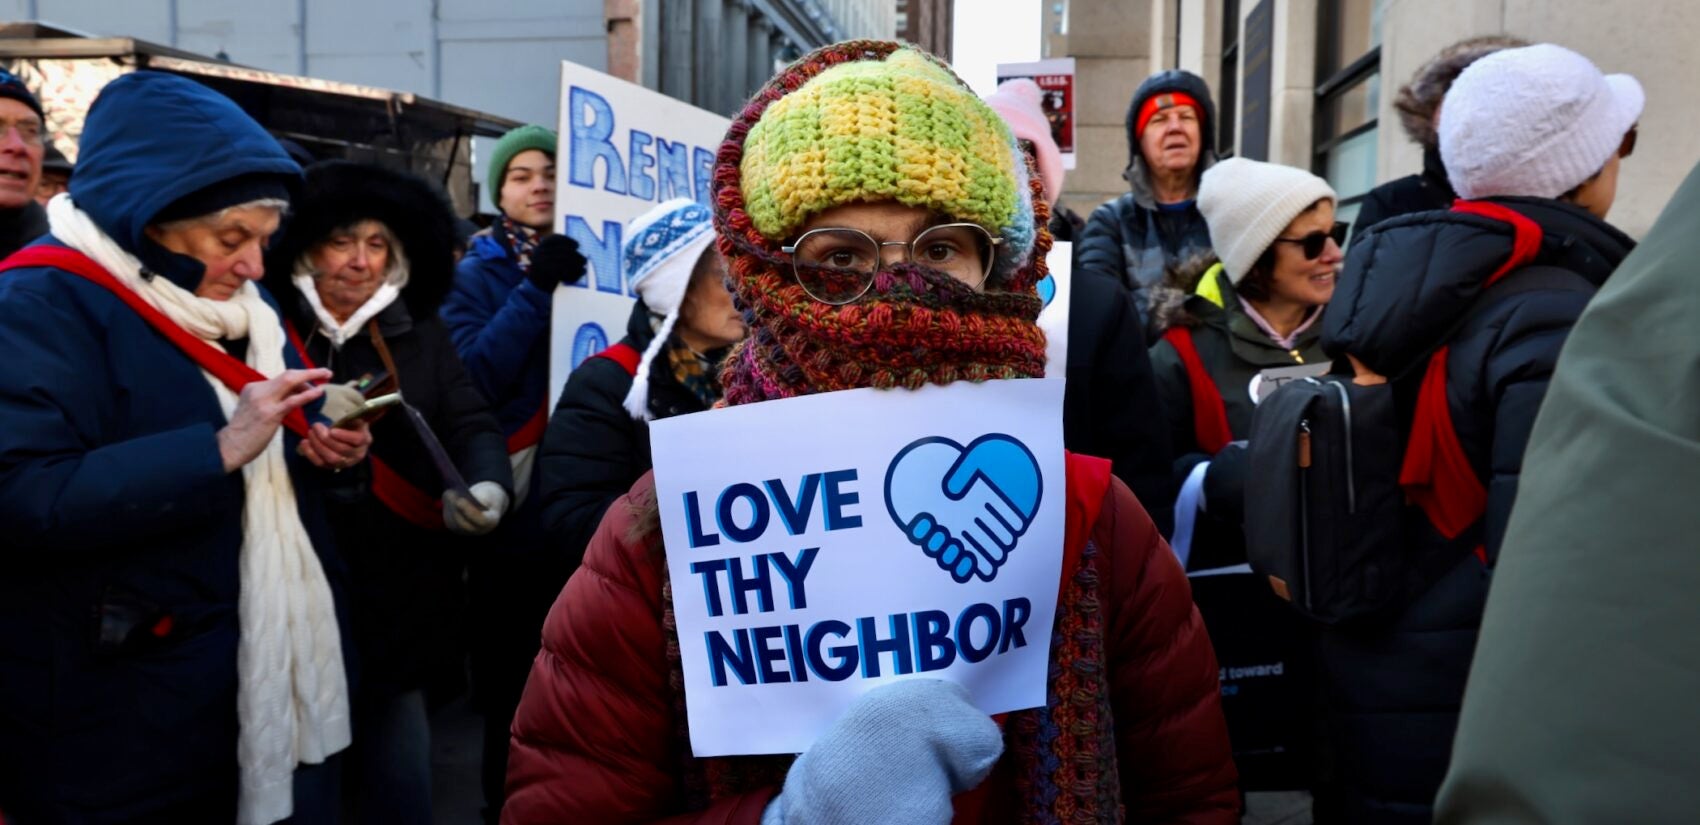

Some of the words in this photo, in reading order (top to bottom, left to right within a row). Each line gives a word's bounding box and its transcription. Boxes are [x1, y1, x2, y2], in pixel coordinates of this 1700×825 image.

[568, 85, 716, 205] RENE
[682, 468, 863, 549] LOVE
[690, 547, 820, 617] THY
[704, 597, 1032, 688] NEIGHBOR
[1228, 661, 1284, 680] toward
